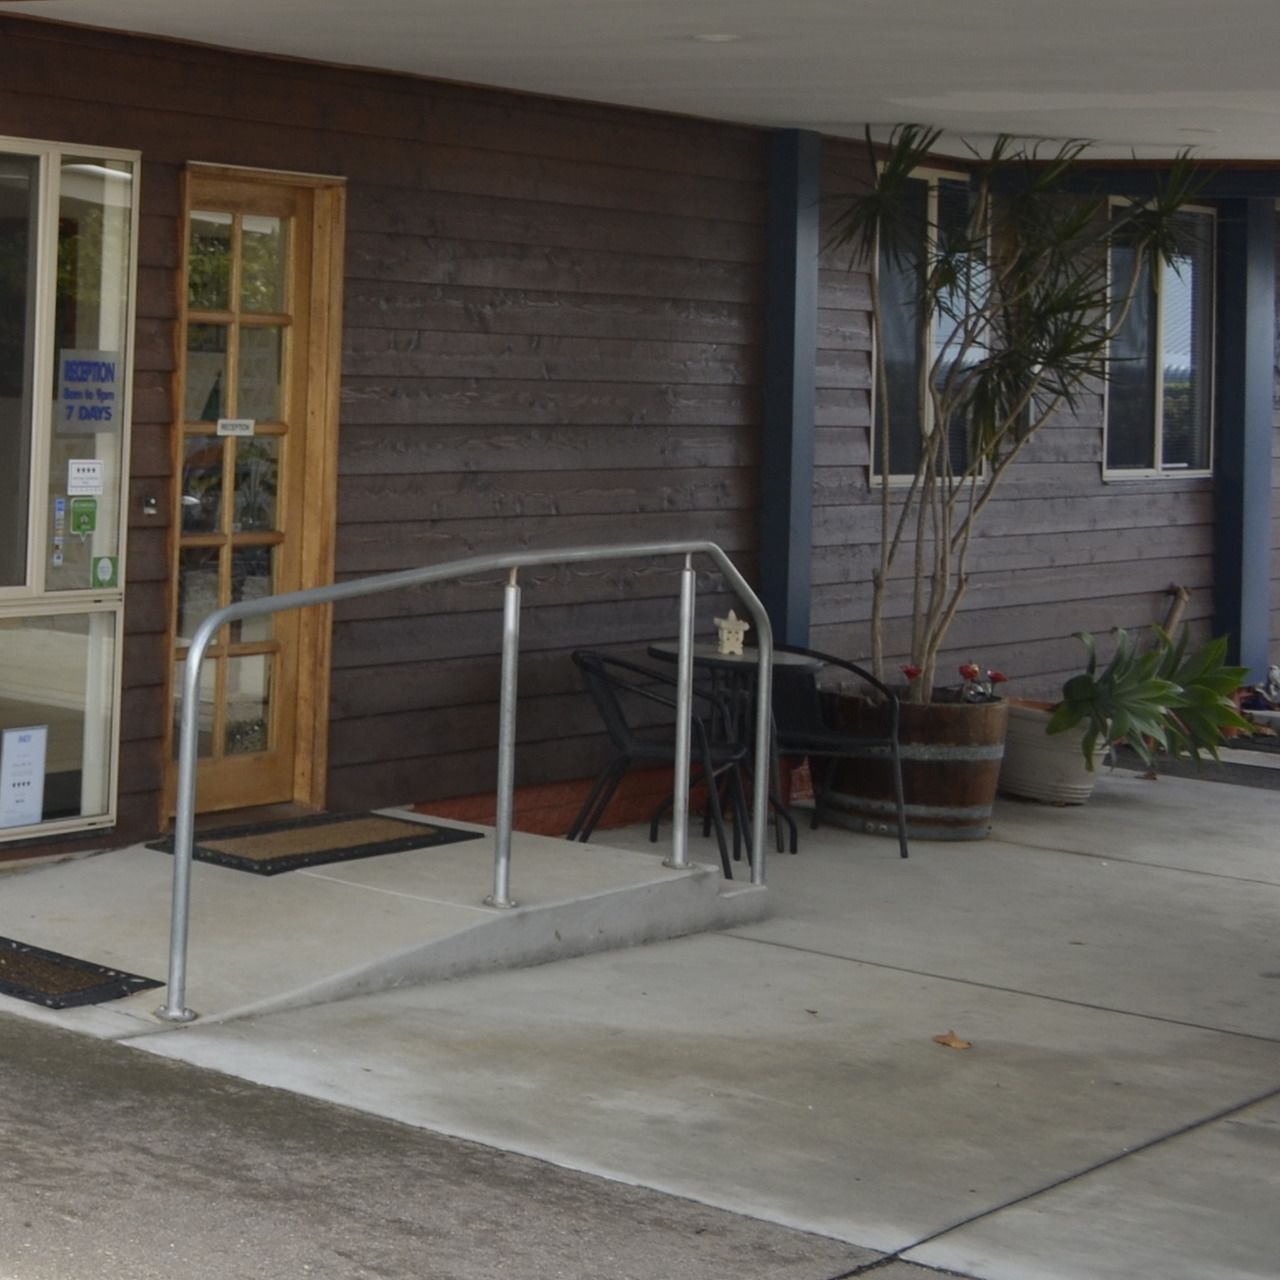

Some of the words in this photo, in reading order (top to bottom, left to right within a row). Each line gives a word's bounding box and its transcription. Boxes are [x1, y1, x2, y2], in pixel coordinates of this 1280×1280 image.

[64, 360, 115, 383] RECEPTION
[66, 404, 75, 421] 7
[78, 406, 113, 421] DAYS
